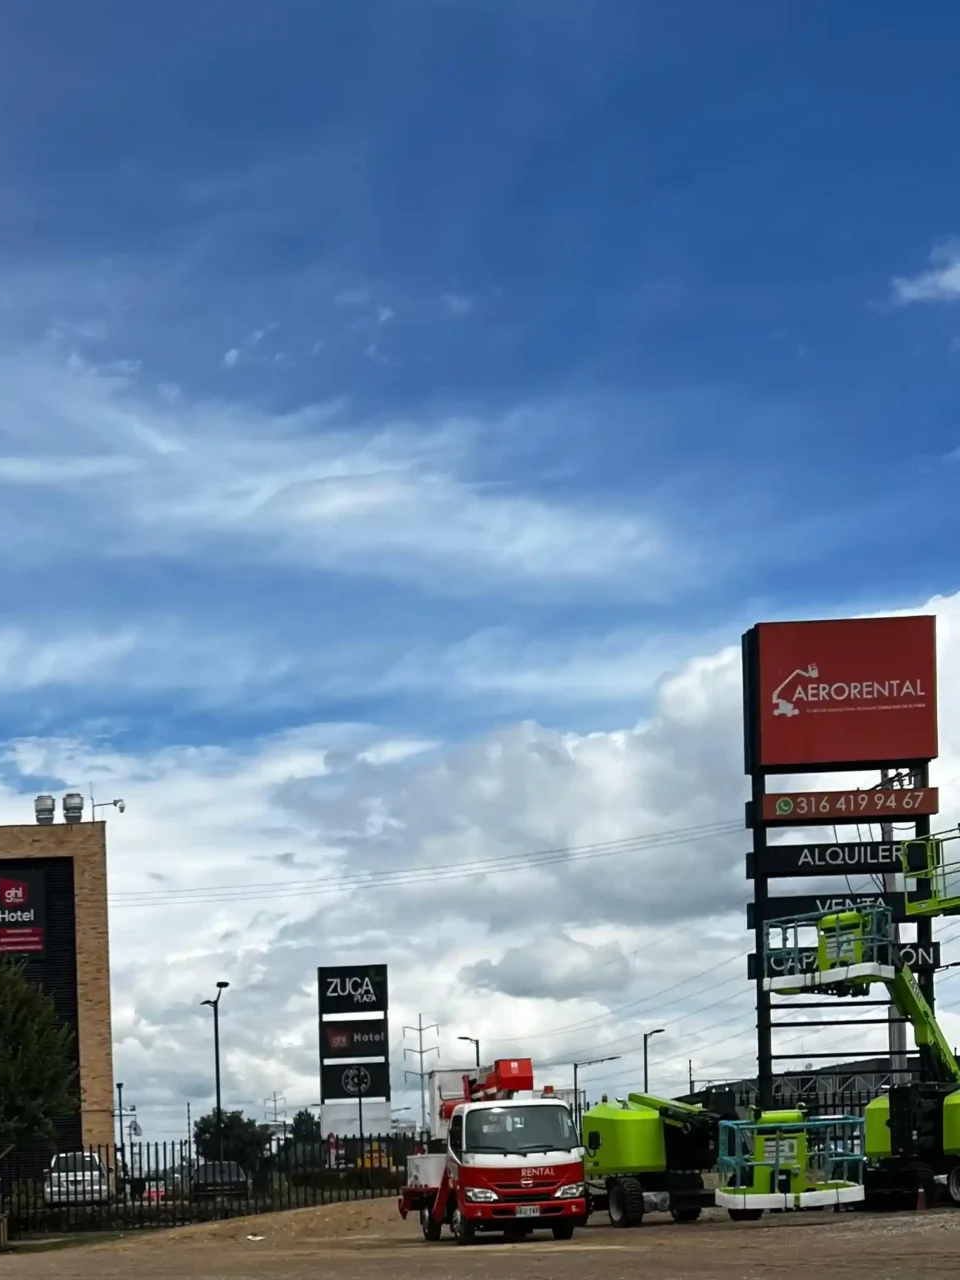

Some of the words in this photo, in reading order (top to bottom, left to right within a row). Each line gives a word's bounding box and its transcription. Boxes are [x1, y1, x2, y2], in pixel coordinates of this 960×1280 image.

[792, 679, 926, 702] AERORENTAL
[797, 796, 830, 814] 316
[836, 794, 868, 812] 419
[874, 793, 897, 810] 94
[902, 792, 925, 809] 67
[798, 845, 905, 866] ALQUILER
[5, 887, 24, 903] ghl
[326, 977, 375, 996] ZUCA
[353, 994, 377, 1004] PLAZA
[353, 1032, 385, 1042] Hotel
[521, 1167, 556, 1177] RENTAL
